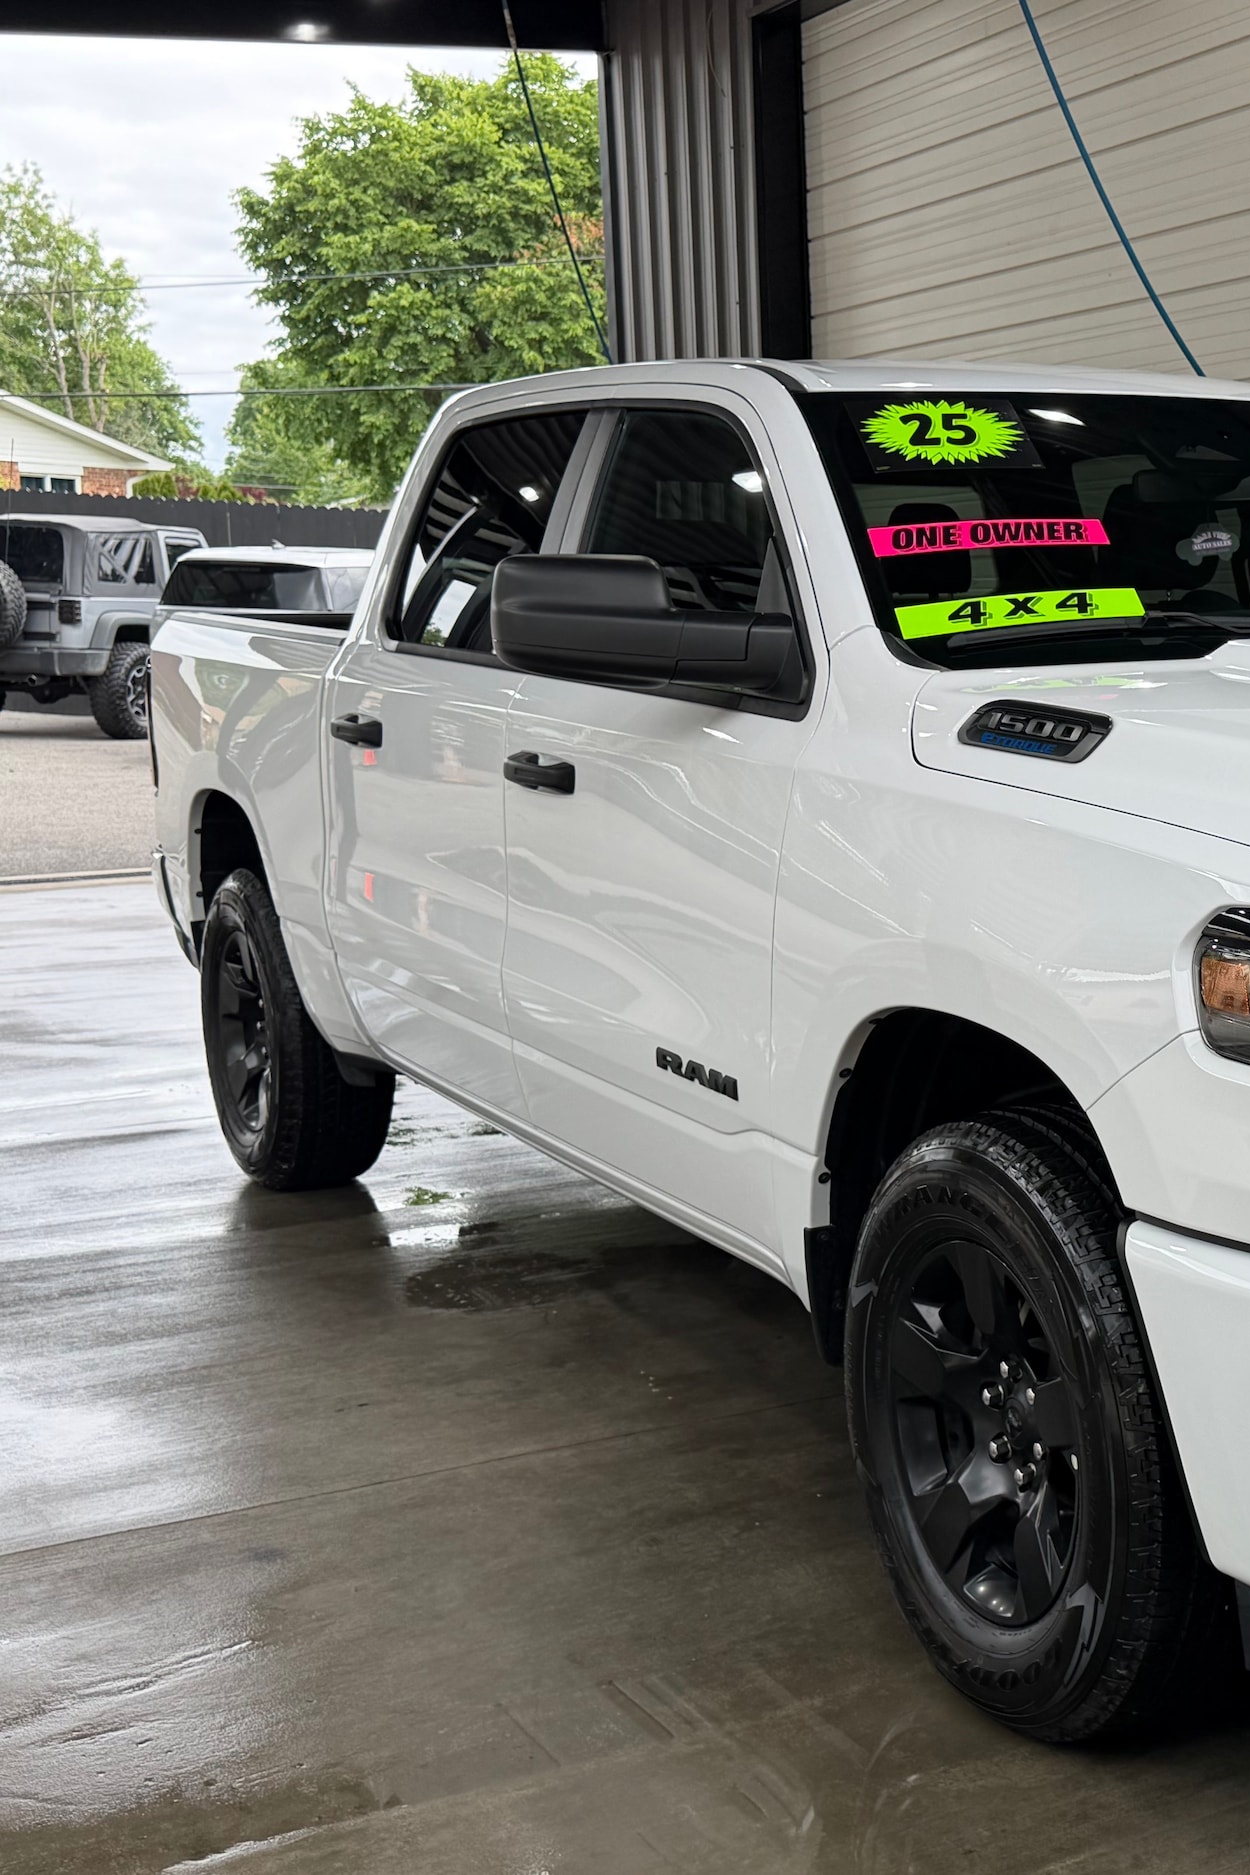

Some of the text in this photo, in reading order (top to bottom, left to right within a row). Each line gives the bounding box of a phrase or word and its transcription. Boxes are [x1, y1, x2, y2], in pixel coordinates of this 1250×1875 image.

[899, 412, 980, 447] 25
[891, 521, 1089, 551] ONE OWNER
[1192, 540, 1232, 551] AUTO SALES
[947, 600, 993, 627] 4
[1055, 592, 1100, 616] 4
[987, 711, 1084, 742] 1500
[656, 1046, 740, 1102] RAM
